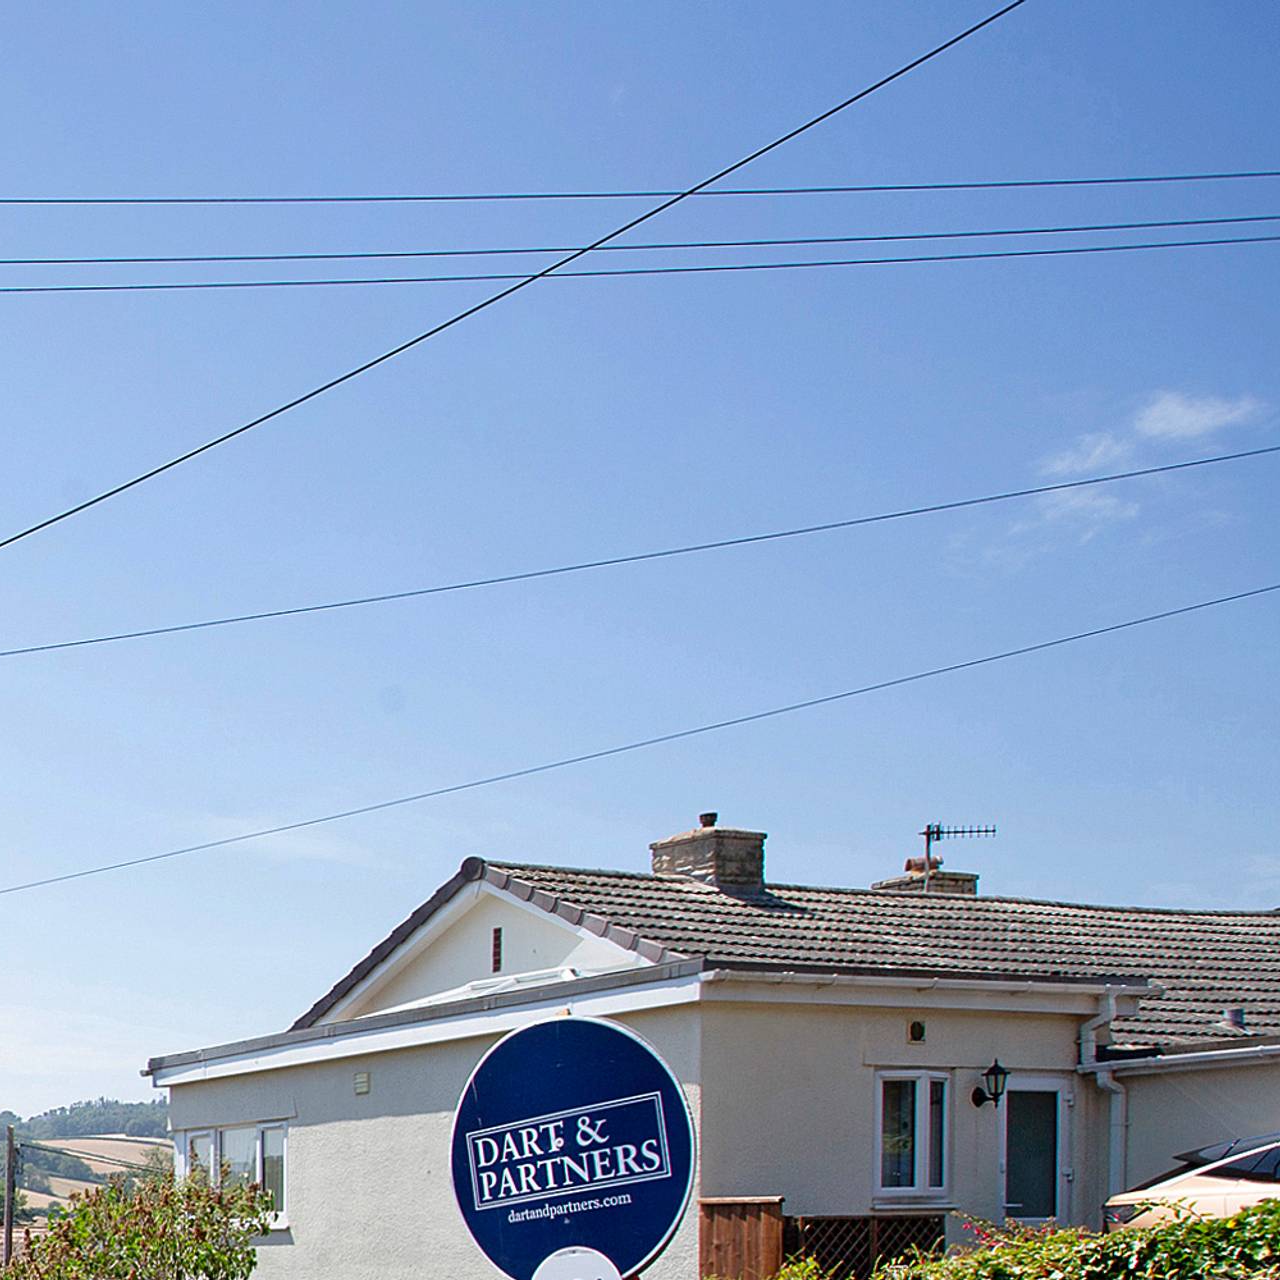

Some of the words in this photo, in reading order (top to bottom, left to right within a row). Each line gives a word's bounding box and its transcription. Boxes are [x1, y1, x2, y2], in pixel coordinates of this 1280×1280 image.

[474, 1120, 564, 1168] DART
[575, 1116, 610, 1147] &
[480, 1139, 660, 1201] PARTNERS
[508, 1193, 632, 1223] dartandpartners.com
